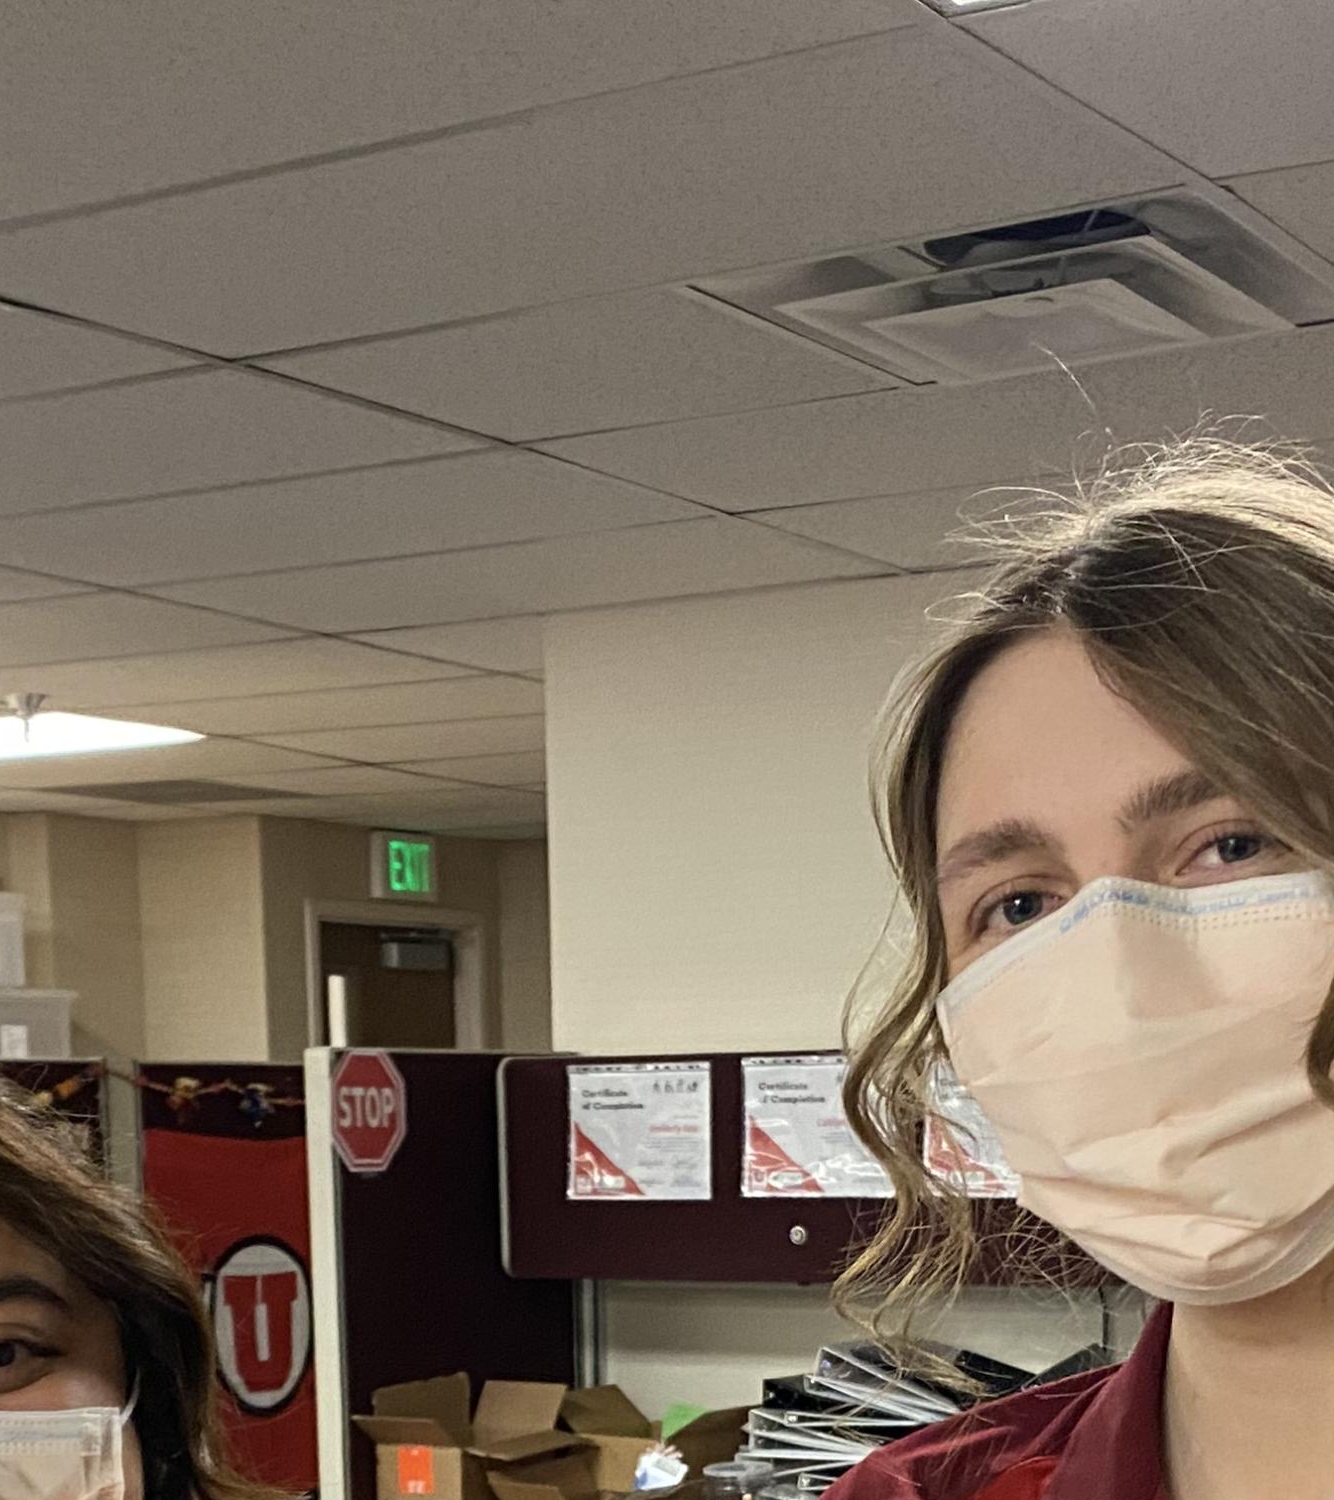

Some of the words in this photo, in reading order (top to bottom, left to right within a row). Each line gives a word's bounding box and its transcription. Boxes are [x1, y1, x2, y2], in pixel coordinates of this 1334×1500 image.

[388, 840, 430, 893] EXIT
[338, 1087, 394, 1128] STOP
[223, 1271, 299, 1393] U
